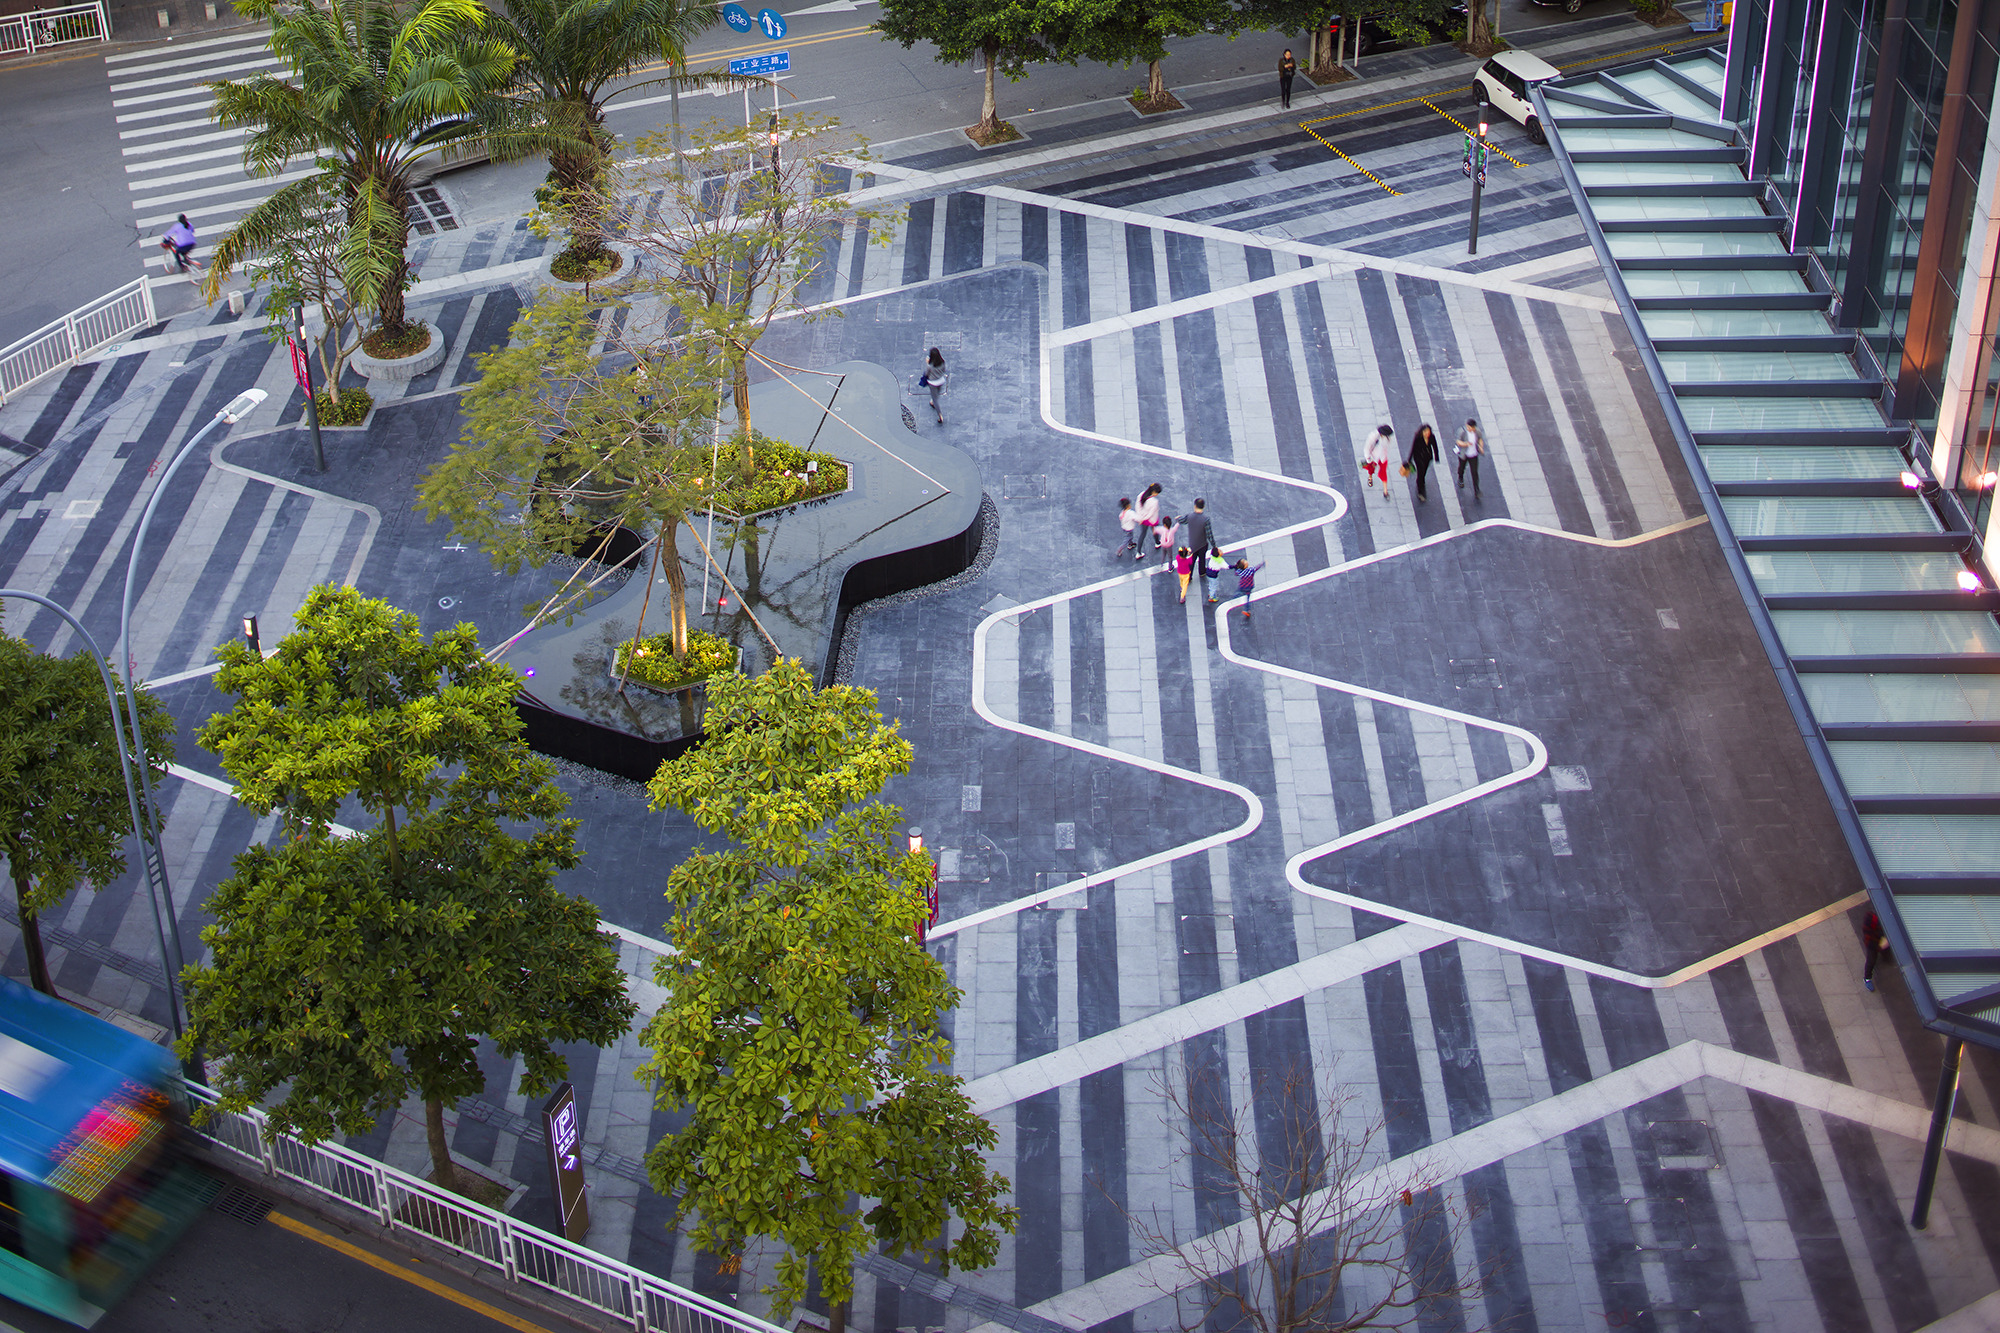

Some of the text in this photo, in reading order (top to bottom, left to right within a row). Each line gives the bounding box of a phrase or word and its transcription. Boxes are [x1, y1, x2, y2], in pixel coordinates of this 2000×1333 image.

[741, 56, 779, 69] 工业三路
[559, 1108, 570, 1136] P
